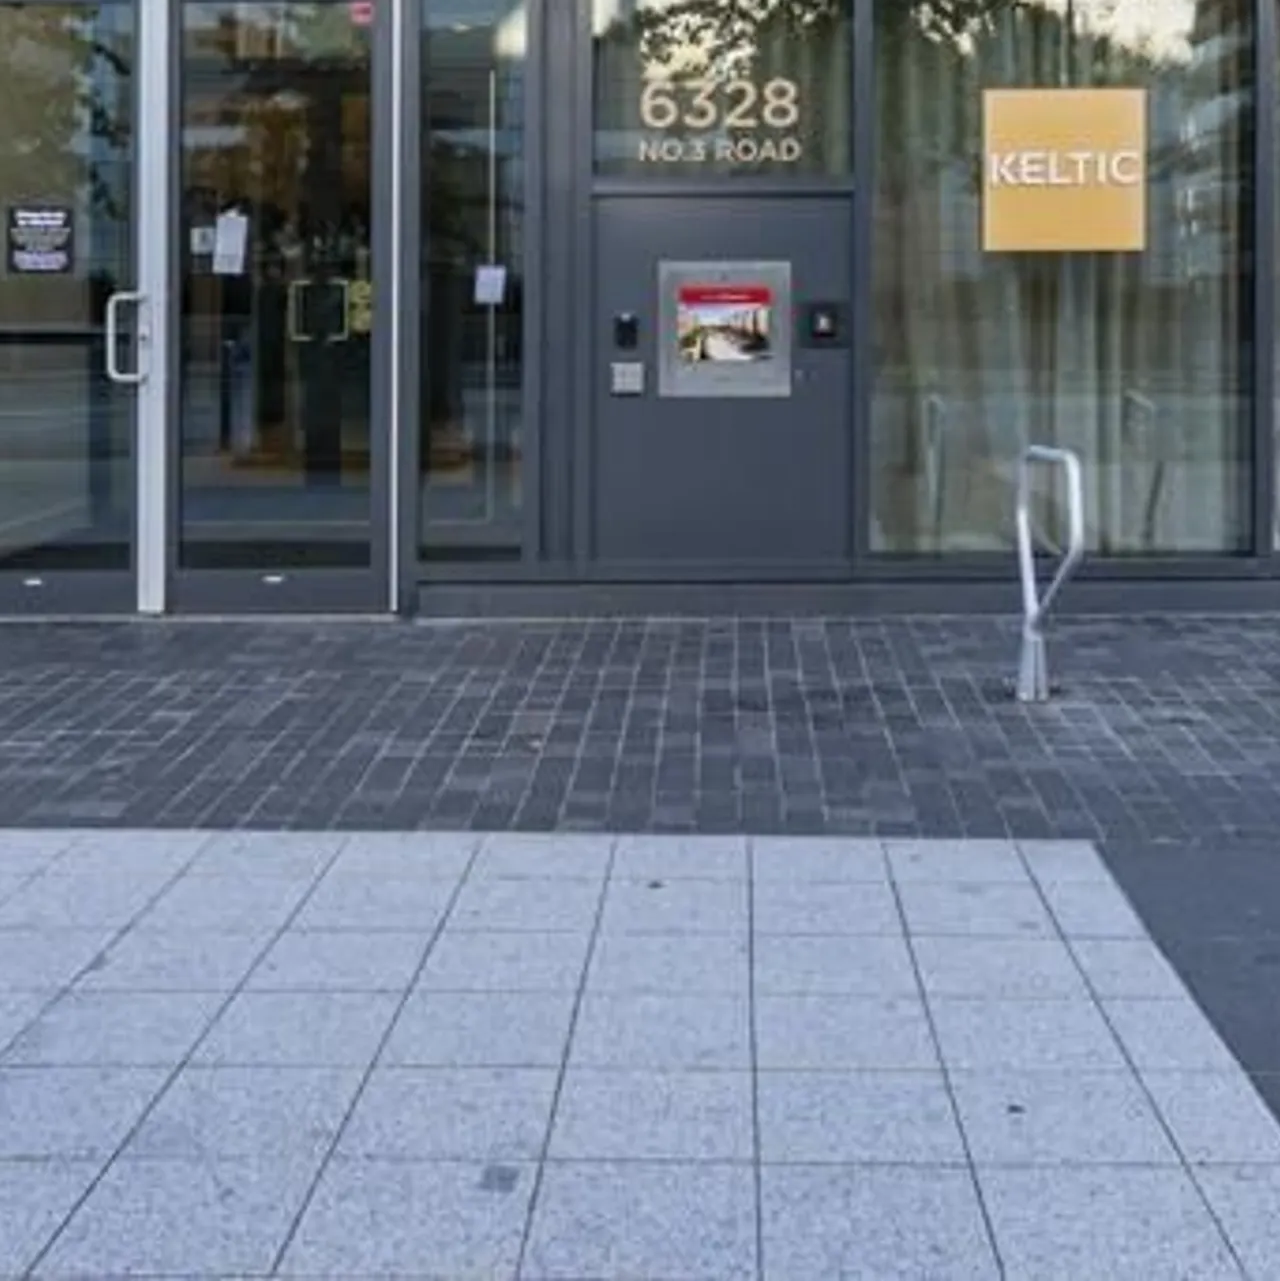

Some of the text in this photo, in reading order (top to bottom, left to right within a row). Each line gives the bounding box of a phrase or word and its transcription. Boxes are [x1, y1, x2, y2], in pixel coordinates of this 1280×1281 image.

[640, 78, 799, 128] 6328
[715, 137, 801, 161] ROAD
[991, 150, 1140, 185] KELTIC
